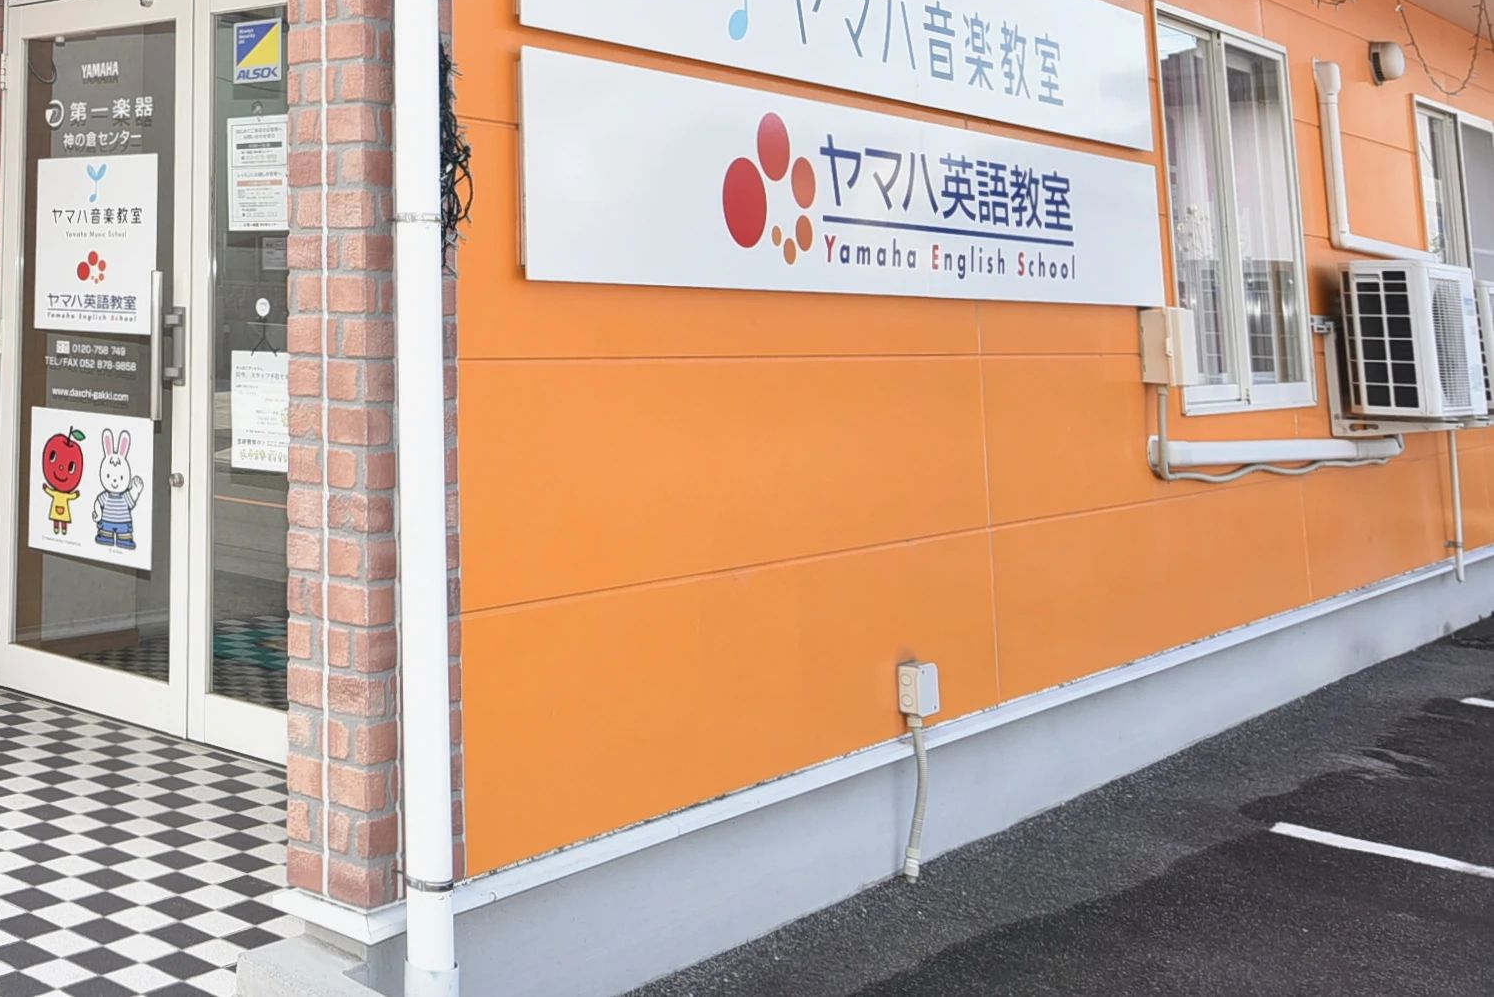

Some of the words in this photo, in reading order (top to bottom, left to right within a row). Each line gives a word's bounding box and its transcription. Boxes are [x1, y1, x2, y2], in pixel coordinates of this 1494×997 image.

[81, 61, 119, 79] YAMAHA
[237, 67, 278, 80] ALSOK
[70, 96, 153, 122] 第一楽器
[63, 130, 142, 149] 神の倉センター
[820, 133, 1074, 232] ヤマハ英語教室
[51, 207, 143, 224] ヤマハ音楽教室
[89, 231, 106, 239] Music
[108, 231, 127, 239] School
[824, 234, 917, 269] Yamaha
[932, 244, 1006, 280] English
[1018, 251, 1076, 280] School
[47, 293, 137, 311] ヤマハ英語教室
[47, 312, 75, 320] Yamaha
[79, 313, 106, 322] English
[111, 314, 137, 323] School
[72, 344, 109, 356] 0120-758
[111, 346, 126, 357] 749
[45, 356, 79, 368] TEL/FAX
[79, 360, 95, 369] 052
